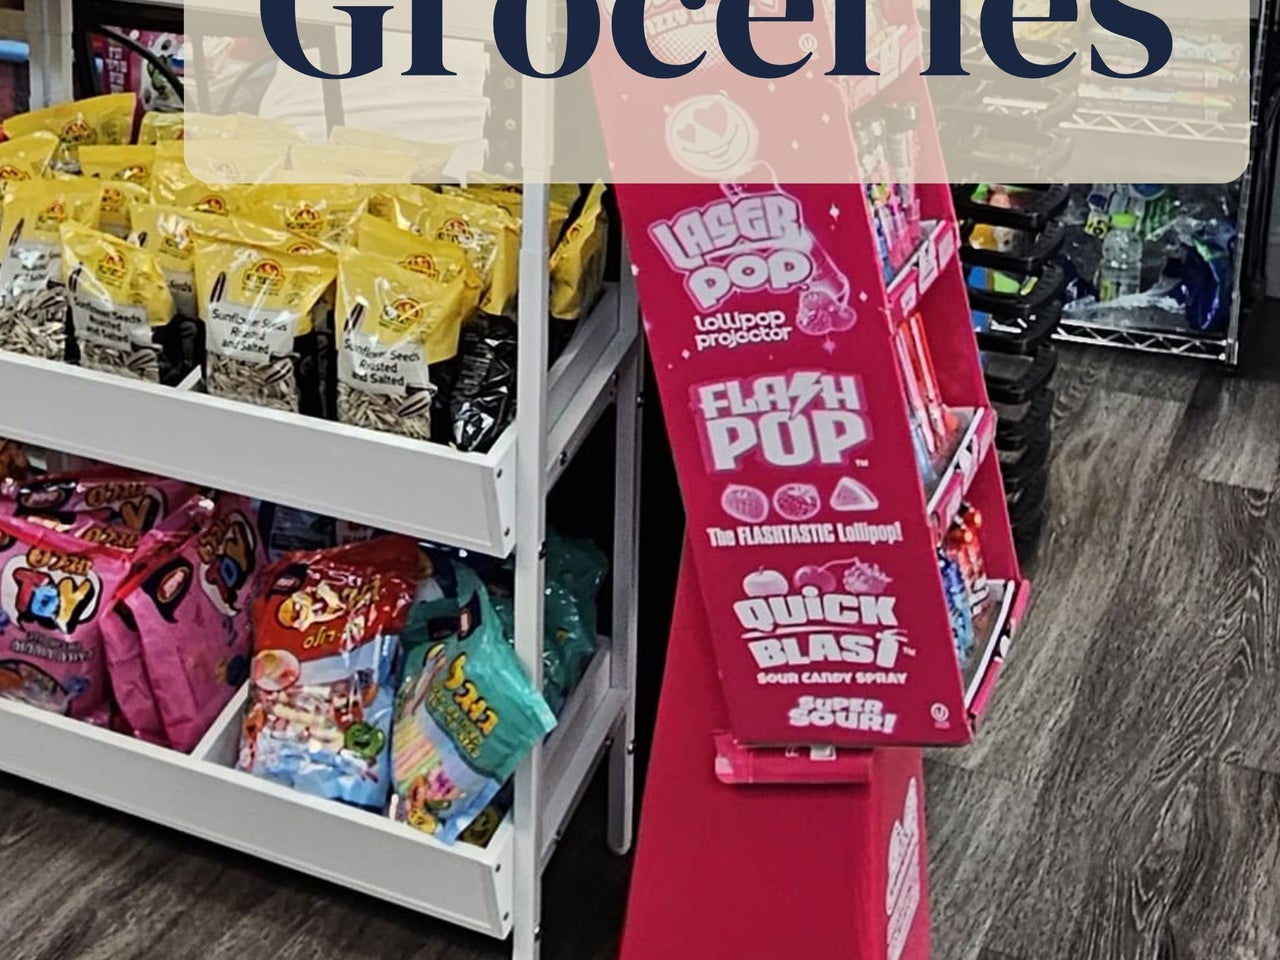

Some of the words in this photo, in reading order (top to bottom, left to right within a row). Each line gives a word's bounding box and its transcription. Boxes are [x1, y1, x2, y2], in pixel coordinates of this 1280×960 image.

[650, 194, 803, 269] LASER
[170, 279, 193, 293] Seeds
[687, 247, 813, 310] POP
[114, 311, 142, 324] Seeds
[101, 328, 129, 342] Salted
[695, 325, 793, 351] projector
[240, 342, 270, 355] Salted
[390, 349, 421, 362] Seeds
[370, 373, 405, 387] Salted
[706, 410, 868, 472] POP
[706, 526, 736, 547] The
[739, 522, 835, 546] FLASHTASTIC
[838, 521, 904, 546] Lollipop!
[13, 567, 93, 633] TOY
[748, 630, 906, 669] BLAST
[757, 672, 798, 685] SOUR
[801, 671, 852, 685] CANDY
[855, 671, 908, 685] SPRAY
[796, 695, 885, 714] SUPER
[788, 708, 899, 735] SOUR!
